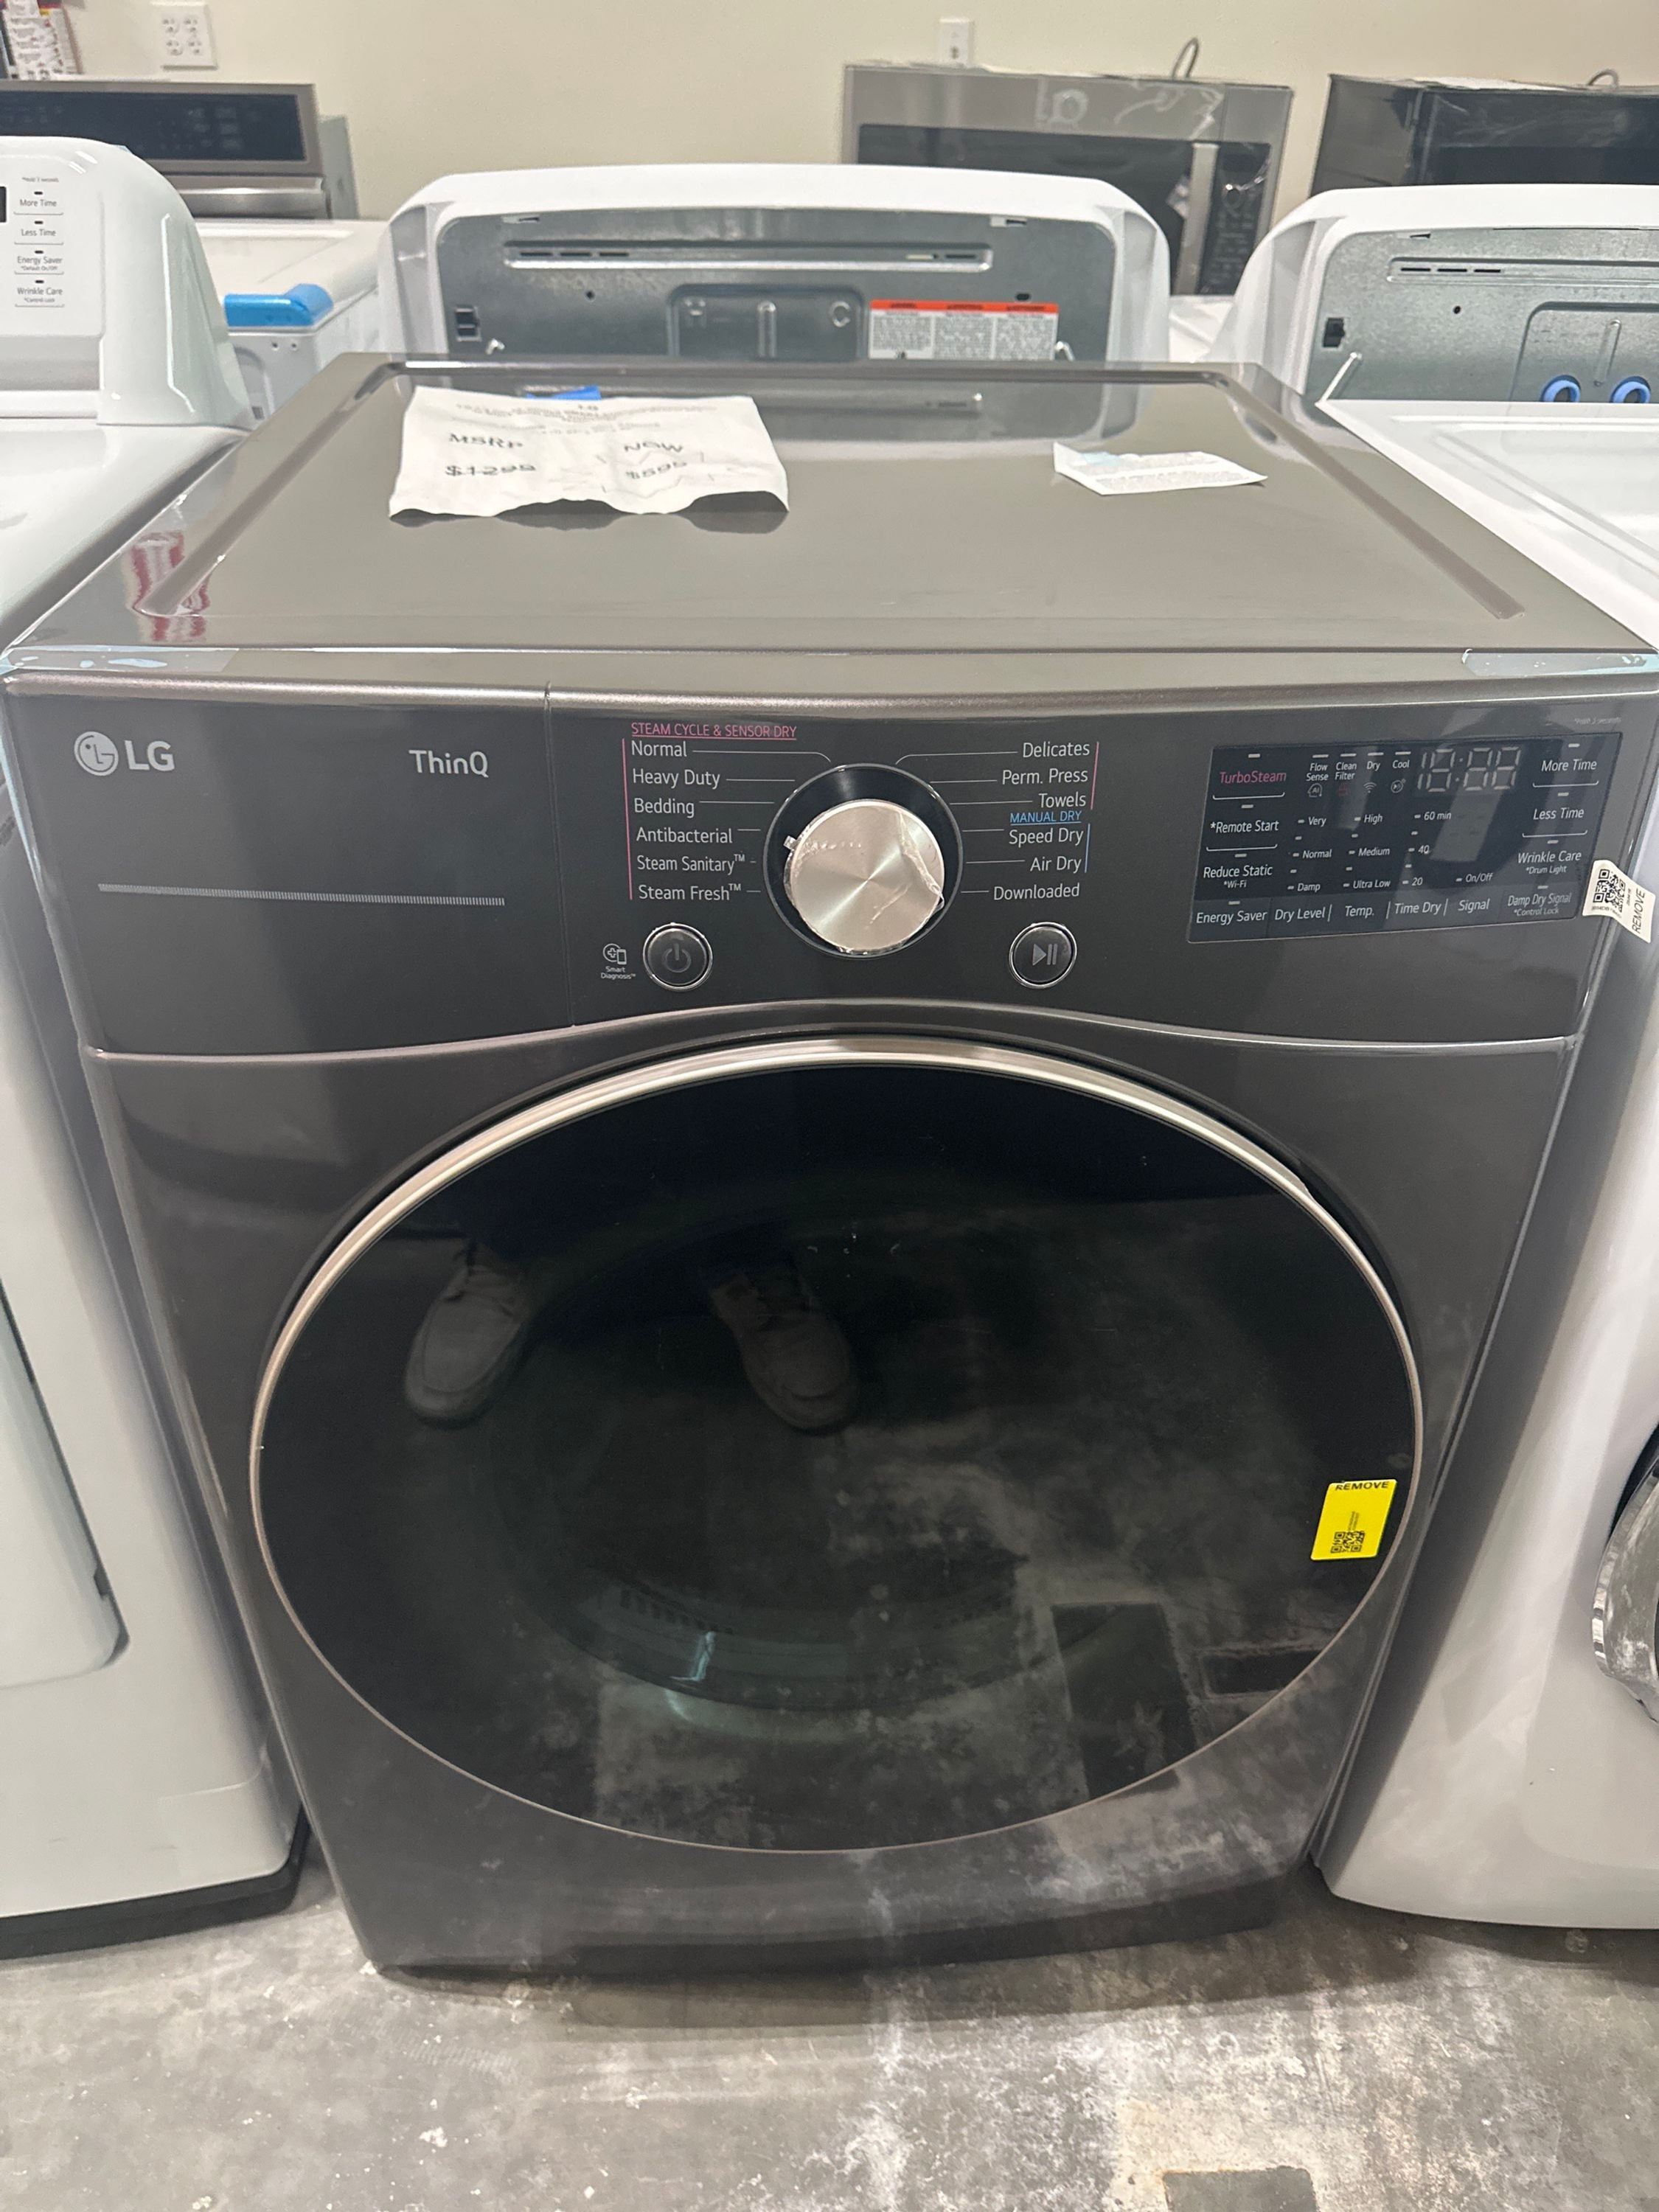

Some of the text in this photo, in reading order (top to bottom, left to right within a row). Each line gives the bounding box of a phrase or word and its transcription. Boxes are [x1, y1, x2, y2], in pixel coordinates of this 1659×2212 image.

[19, 198, 57, 207] More Time
[21, 229, 56, 237] Less Time
[17, 256, 41, 265] Energy
[17, 287, 63, 296] Wrinkle Care
[448, 432, 684, 453] MSRP NOW
[631, 723, 797, 738] STEAM CYCLE & SENSOR DRY
[631, 740, 687, 757] Normal
[1023, 741, 1090, 758] Delicates
[124, 740, 175, 772] LG
[408, 749, 490, 778] ThinQ
[1310, 762, 1329, 772] Flow
[1335, 761, 1357, 771] Clean
[1366, 760, 1381, 771] Dry
[1392, 759, 1410, 769] Cool
[1541, 758, 1598, 773] More Time
[633, 768, 720, 790] Heavy Duty
[1002, 768, 1088, 785] Perm. Press
[1220, 771, 1287, 784] TurboSteam
[1306, 773, 1329, 782] Sense
[1335, 771, 1355, 781] Filter
[1038, 792, 1087, 809] Towels
[634, 798, 695, 818] Bedding
[1533, 807, 1585, 821] Less Time
[1009, 811, 1082, 824] MANUAL DRY
[1308, 816, 1326, 827] Very
[1364, 814, 1383, 825] High
[1424, 812, 1452, 821] 60 min
[1254, 820, 1280, 832] Start
[636, 827, 733, 844] Antibacterial
[1009, 827, 1084, 848] Speed Dry
[1302, 849, 1332, 859] Normal
[1358, 846, 1391, 857] Medium
[1418, 844, 1430, 854] 40
[1517, 849, 1582, 864] Wrinkle Care
[637, 855, 678, 872] Steam
[1030, 857, 1082, 874] Air Dry
[1549, 864, 1567, 875] Light
[1203, 864, 1273, 878] Reduce Static
[1465, 872, 1493, 883] On/Off
[1353, 879, 1391, 889] Ultra Low
[1411, 877, 1423, 886] 20
[639, 885, 686, 900] Steam
[994, 883, 1080, 900] Downloaded
[1297, 883, 1321, 894] Damp
[1458, 899, 1491, 913] Signal
[1507, 891, 1573, 908] Damp Dry Signal
[1345, 905, 1375, 918] Temp.
[1394, 900, 1443, 916] Time Dry
[1543, 905, 1559, 916] Lock
[1632, 888, 1646, 934] REMOVE
[1196, 911, 1267, 926] Energy Saver
[1274, 907, 1326, 923] Dry Level
[1335, 1481, 1390, 1491] REMOVE
